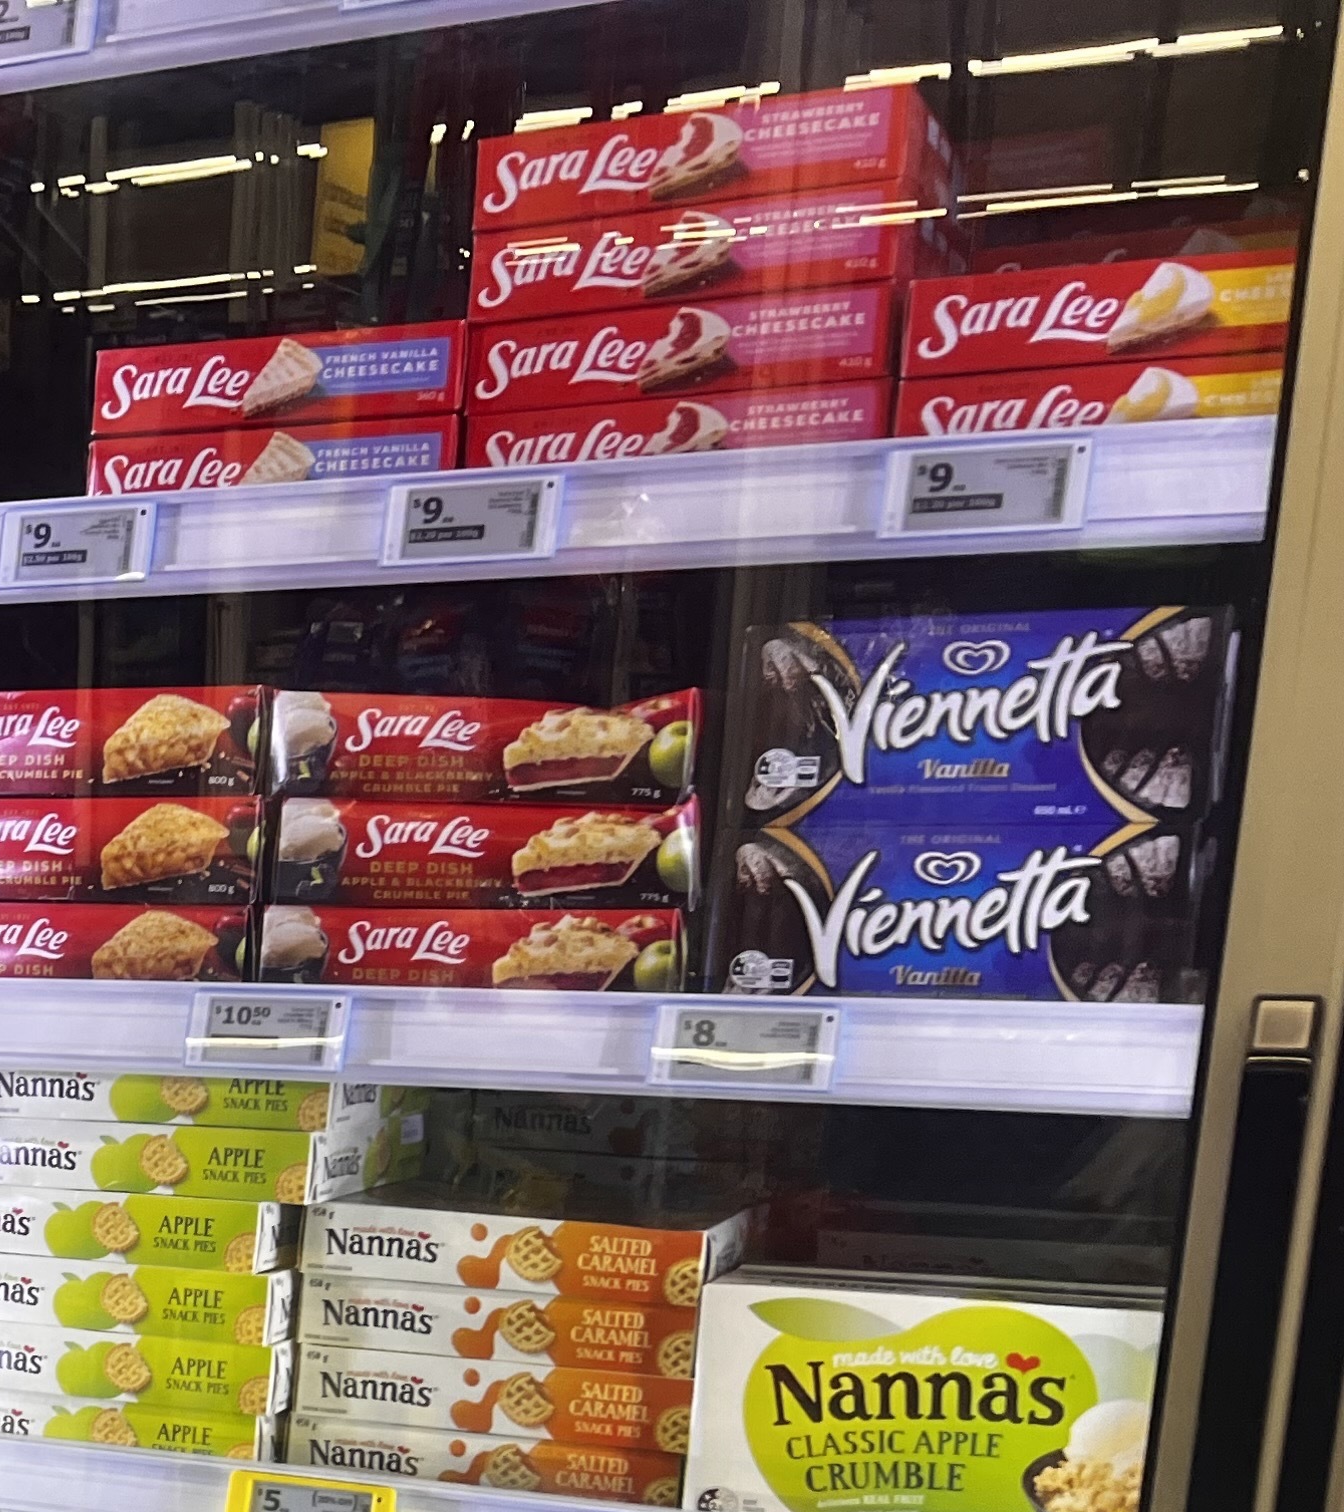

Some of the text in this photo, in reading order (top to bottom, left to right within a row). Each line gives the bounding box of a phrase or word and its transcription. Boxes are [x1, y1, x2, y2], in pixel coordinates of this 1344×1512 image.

[761, 101, 865, 125] STRAWBERRY
[744, 111, 881, 141] CHEESECAKE
[485, 134, 657, 214] Sara Lee
[748, 301, 851, 322] STRAWBERRY
[918, 281, 1119, 359] Sara Lee
[731, 312, 867, 338] CHEESECAKE
[324, 346, 440, 365] FRENCH VANILLA
[322, 359, 440, 379] CHEESECAKE
[102, 355, 250, 420] Sara Lee
[314, 452, 431, 472] CHEESECAKE
[316, 441, 430, 461] FRENCH VANILLA
[811, 630, 1132, 785] Viennetta
[28, 706, 80, 748] Lee
[347, 707, 480, 753] Sara Lee
[25, 754, 64, 766] DISH
[359, 753, 462, 767] DEEP DISH
[918, 757, 1010, 780] Vanilla
[63, 770, 83, 779] PIE
[784, 844, 1101, 988] Viennetta
[890, 964, 981, 988] Vanilla
[158, 1216, 216, 1237] APPLE
[153, 1237, 216, 1253] SNACK PIES
[589, 1235, 652, 1257] SALTED
[577, 1255, 658, 1276] CARAMEL
[583, 1276, 650, 1292] SNACK PIES
[171, 1357, 227, 1380] APPLE
[832, 1346, 999, 1369] made with love
[786, 1430, 1003, 1460] CLASSIC APPLE
[805, 1461, 966, 1492] CRUMBLE
